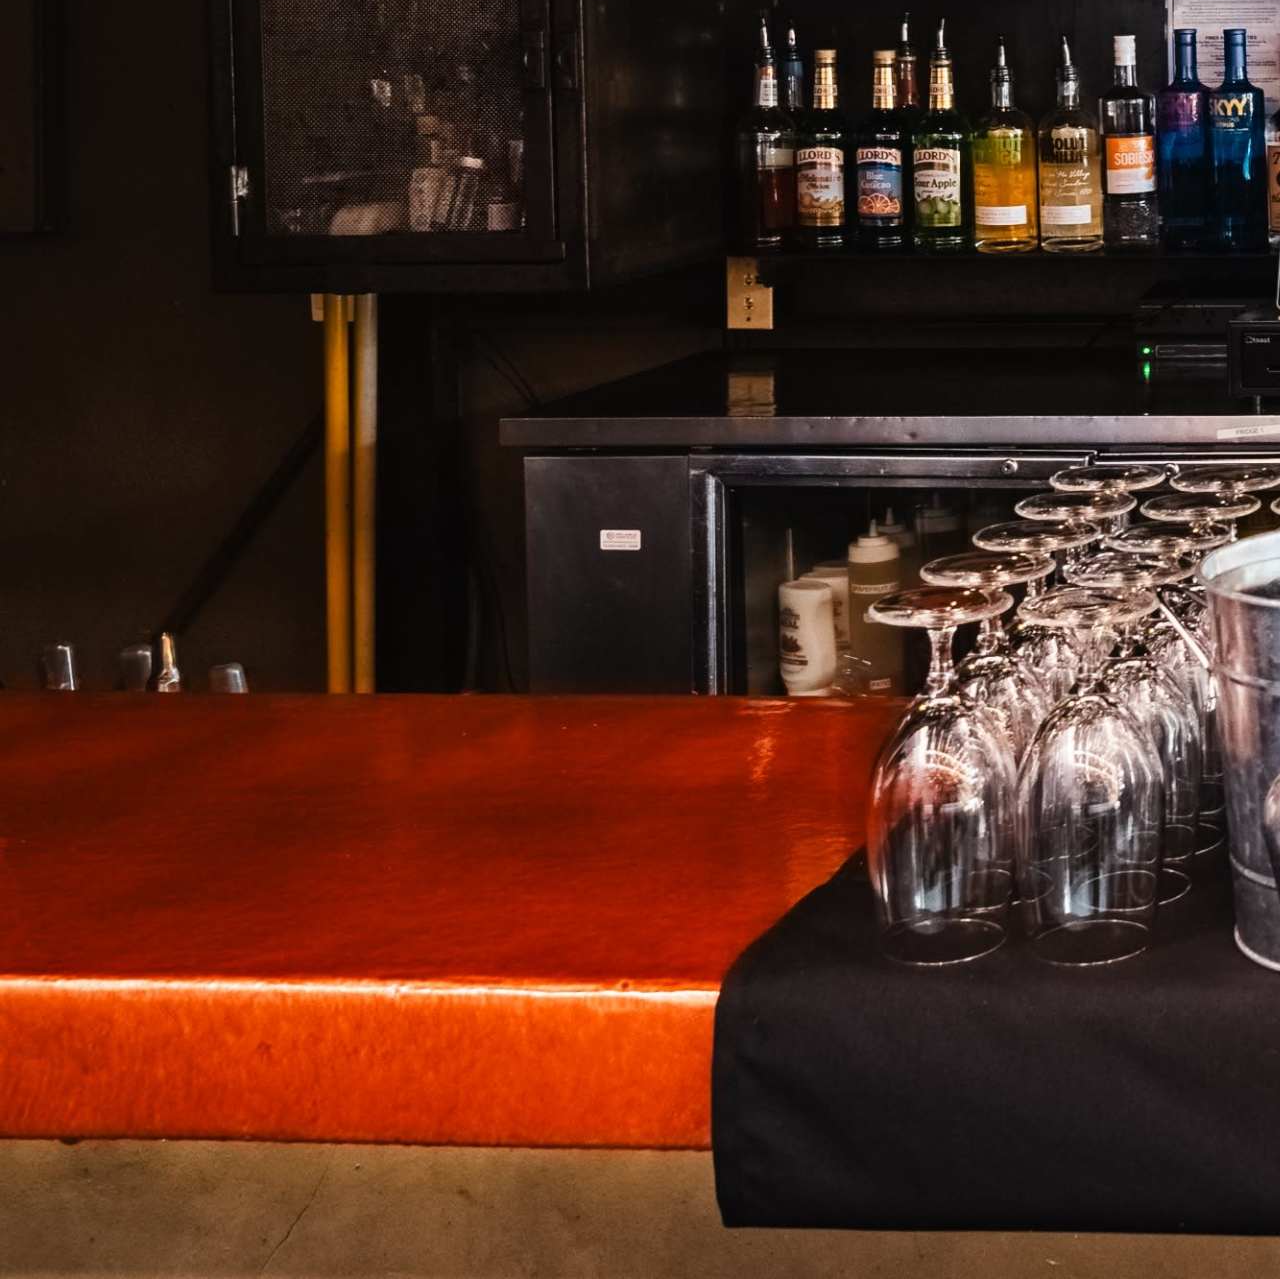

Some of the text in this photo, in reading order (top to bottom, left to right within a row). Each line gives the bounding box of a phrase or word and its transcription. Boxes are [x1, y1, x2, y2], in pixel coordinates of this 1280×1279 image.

[1209, 99, 1247, 116] SKYY
[866, 172, 884, 180] Blue
[931, 177, 957, 190] Apple
